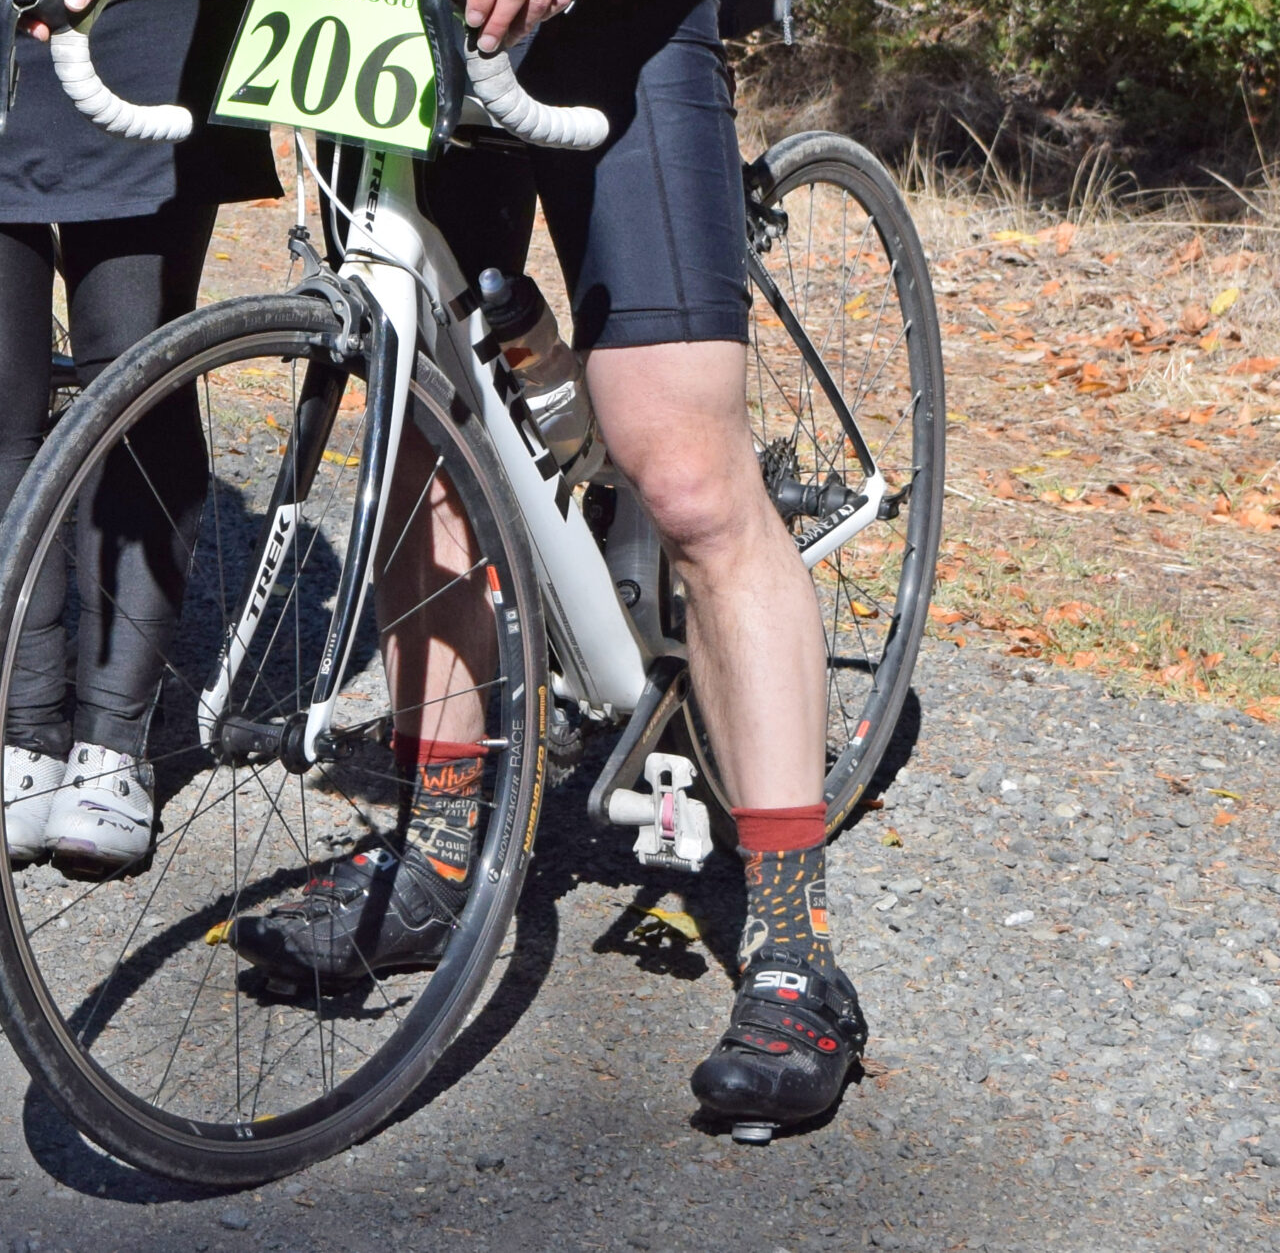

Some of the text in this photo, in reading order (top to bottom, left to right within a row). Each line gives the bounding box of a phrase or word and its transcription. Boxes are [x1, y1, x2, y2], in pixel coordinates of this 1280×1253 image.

[227, 10, 426, 129] 206
[424, 14, 445, 107] ULTEGRA
[246, 512, 291, 622] TREK
[497, 719, 525, 863] BONTRAGER RACE
[753, 970, 808, 993] SIDI
